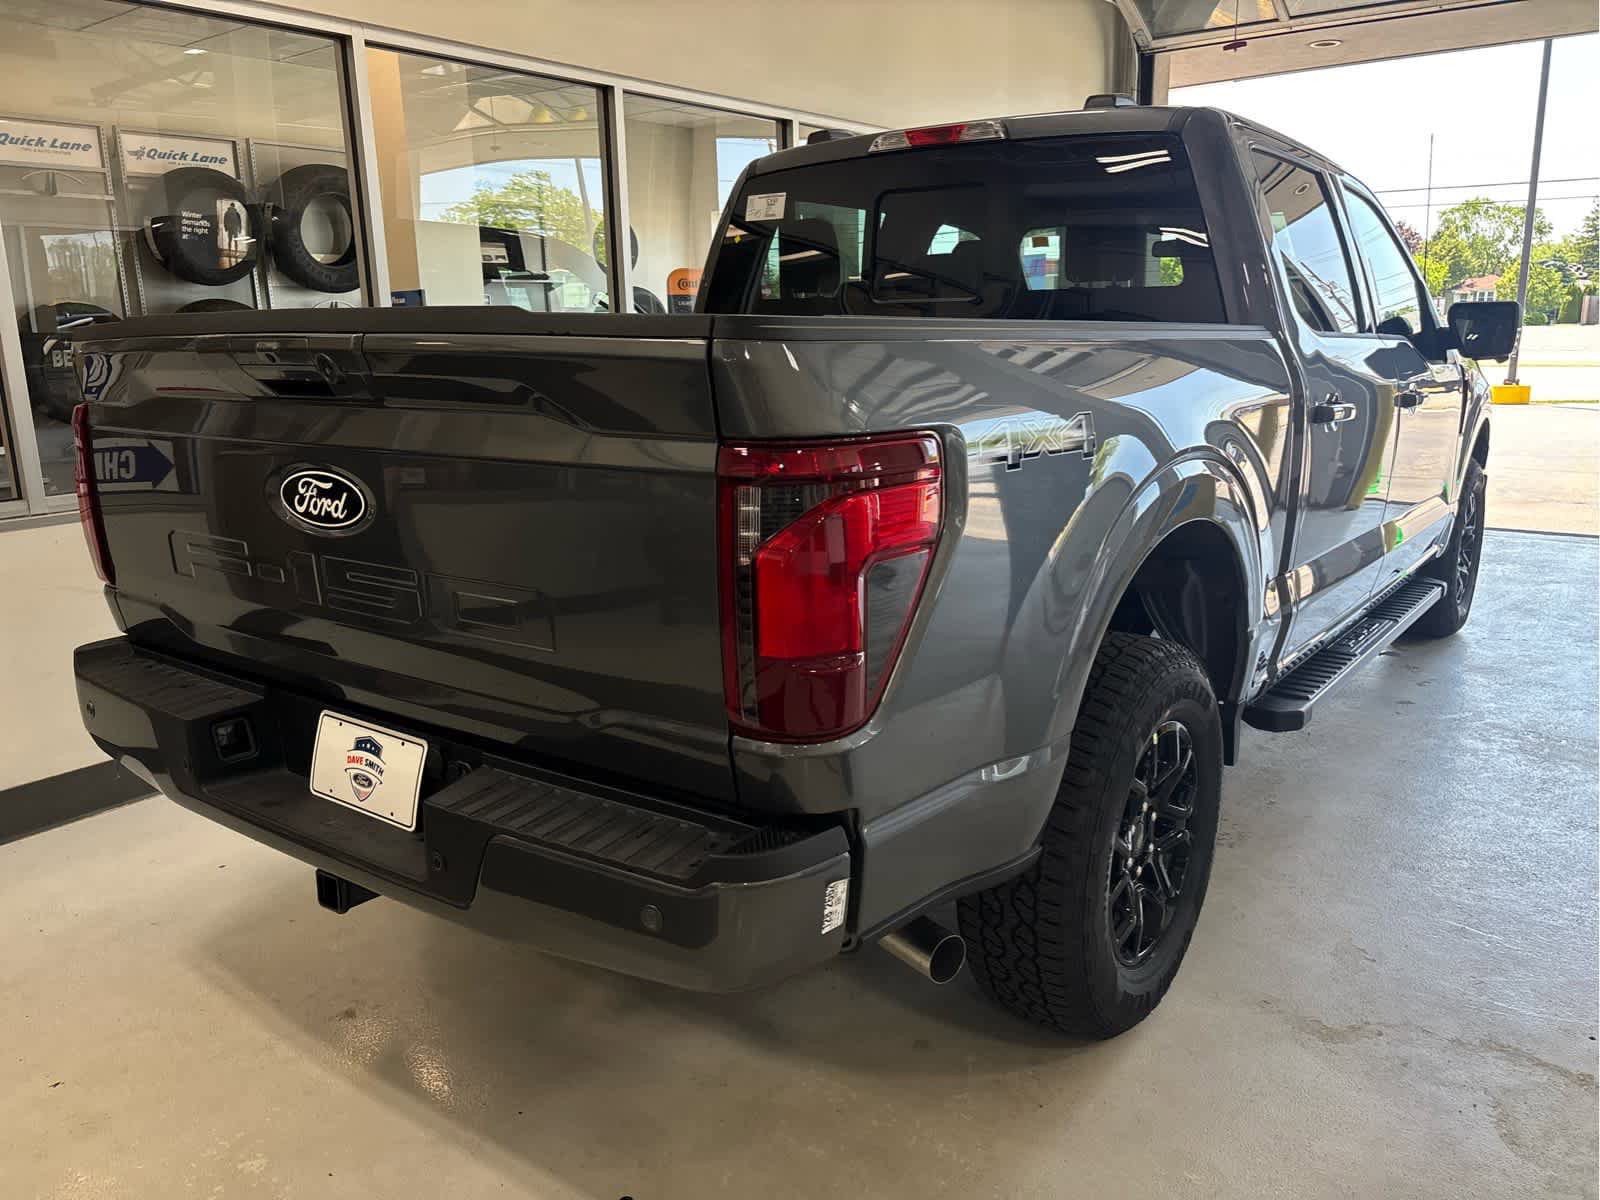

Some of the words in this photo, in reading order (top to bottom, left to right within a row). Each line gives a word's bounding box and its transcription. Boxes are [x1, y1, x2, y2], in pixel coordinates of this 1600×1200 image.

[0, 133, 48, 148] Quick
[50, 138, 93, 152] Lane
[146, 148, 189, 161] Quick
[191, 152, 228, 165] Lane
[182, 219, 210, 227] demands
[194, 227, 208, 235] right
[294, 477, 348, 520] Ford
[168, 529, 558, 653] F-150
[347, 755, 364, 766] DAVE
[364, 758, 385, 778] SMITH
